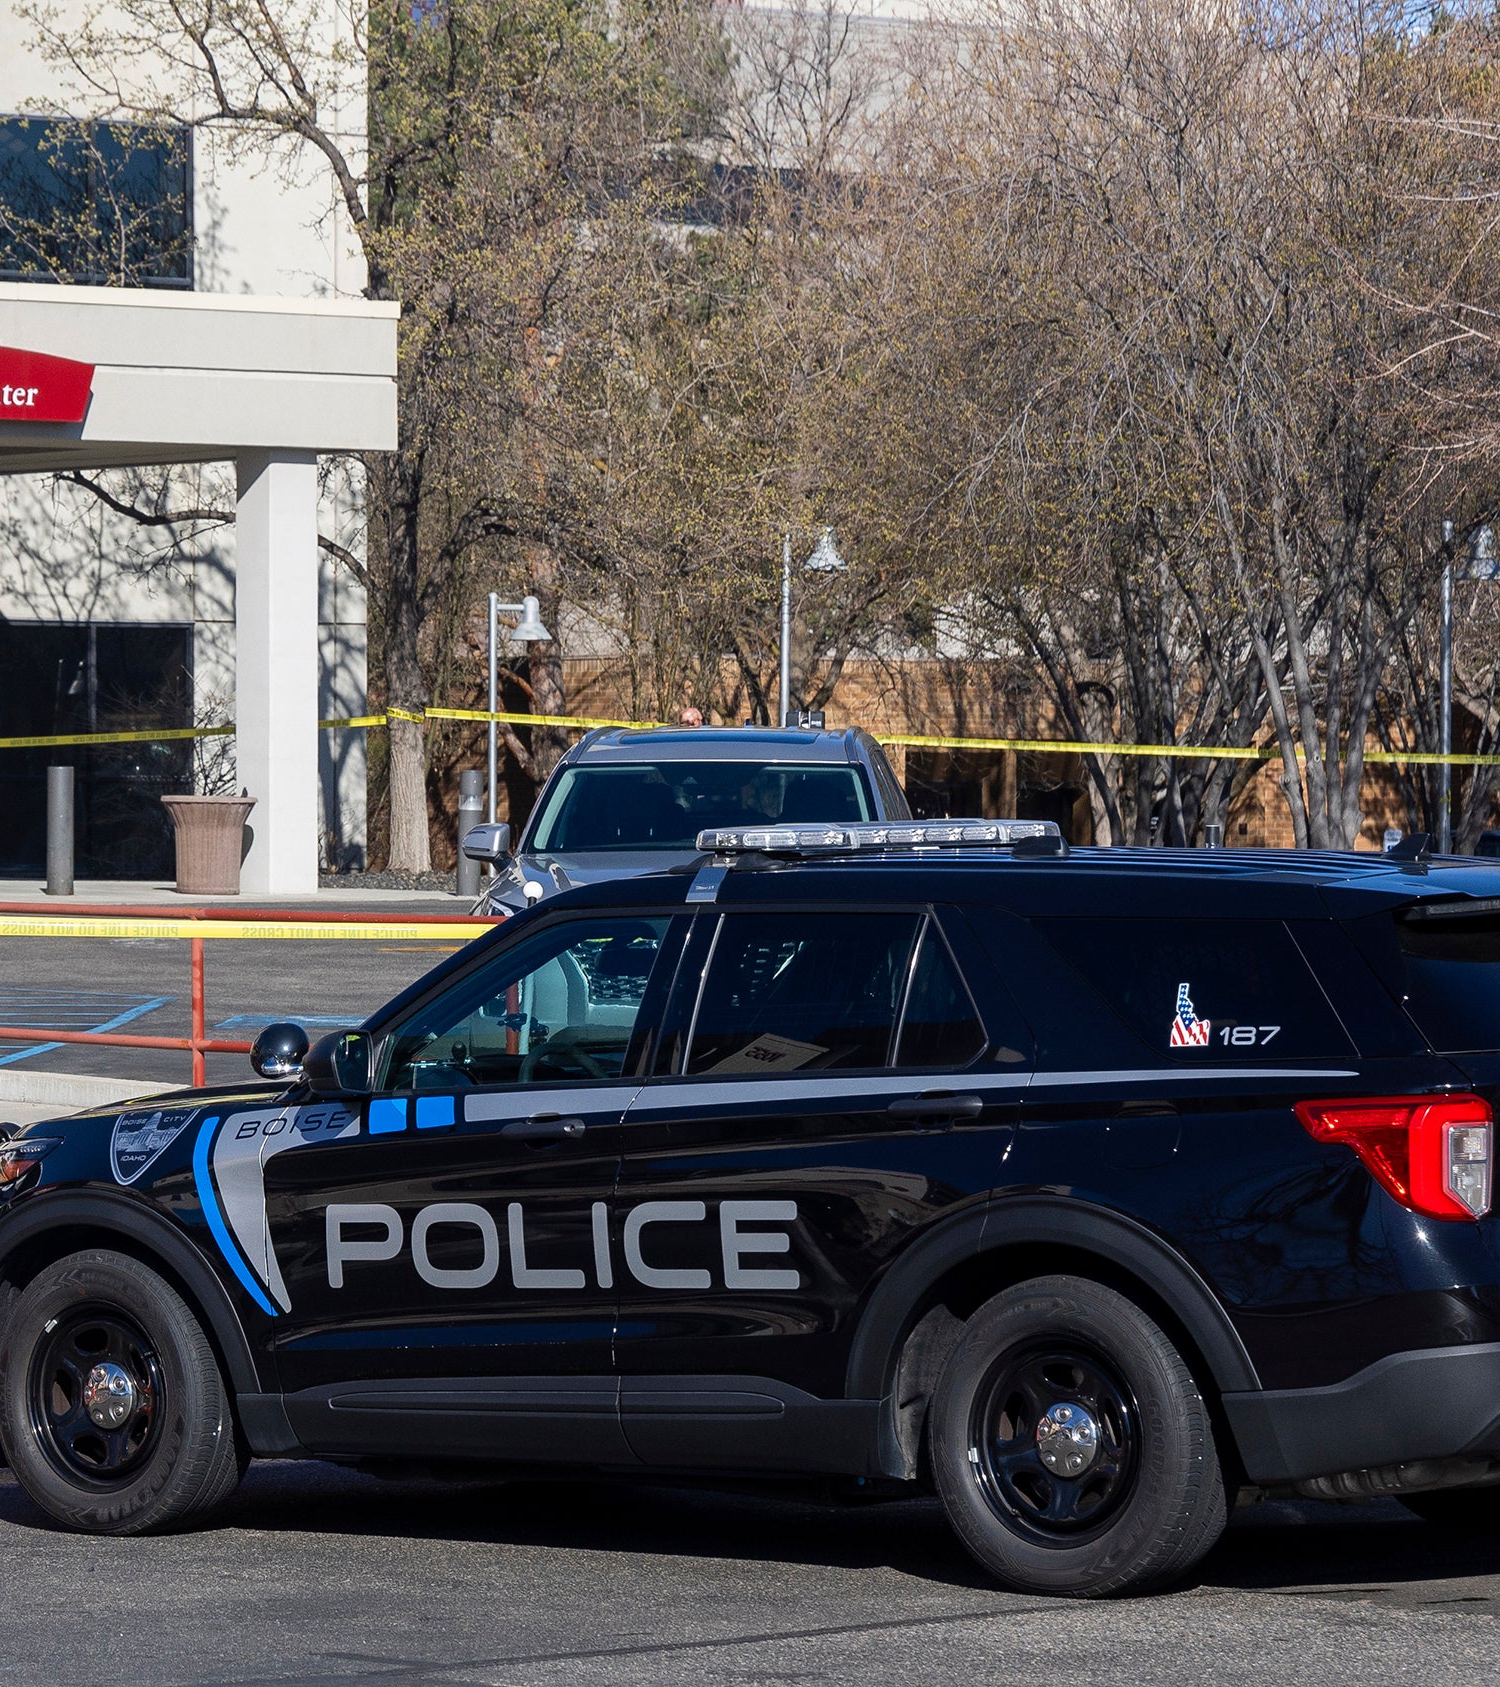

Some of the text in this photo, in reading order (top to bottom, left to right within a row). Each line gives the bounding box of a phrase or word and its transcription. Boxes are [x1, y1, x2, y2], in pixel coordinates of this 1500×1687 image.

[1220, 1026, 1281, 1046] 187
[235, 1110, 352, 1140] BOISE
[325, 1200, 800, 1290] POLICE
